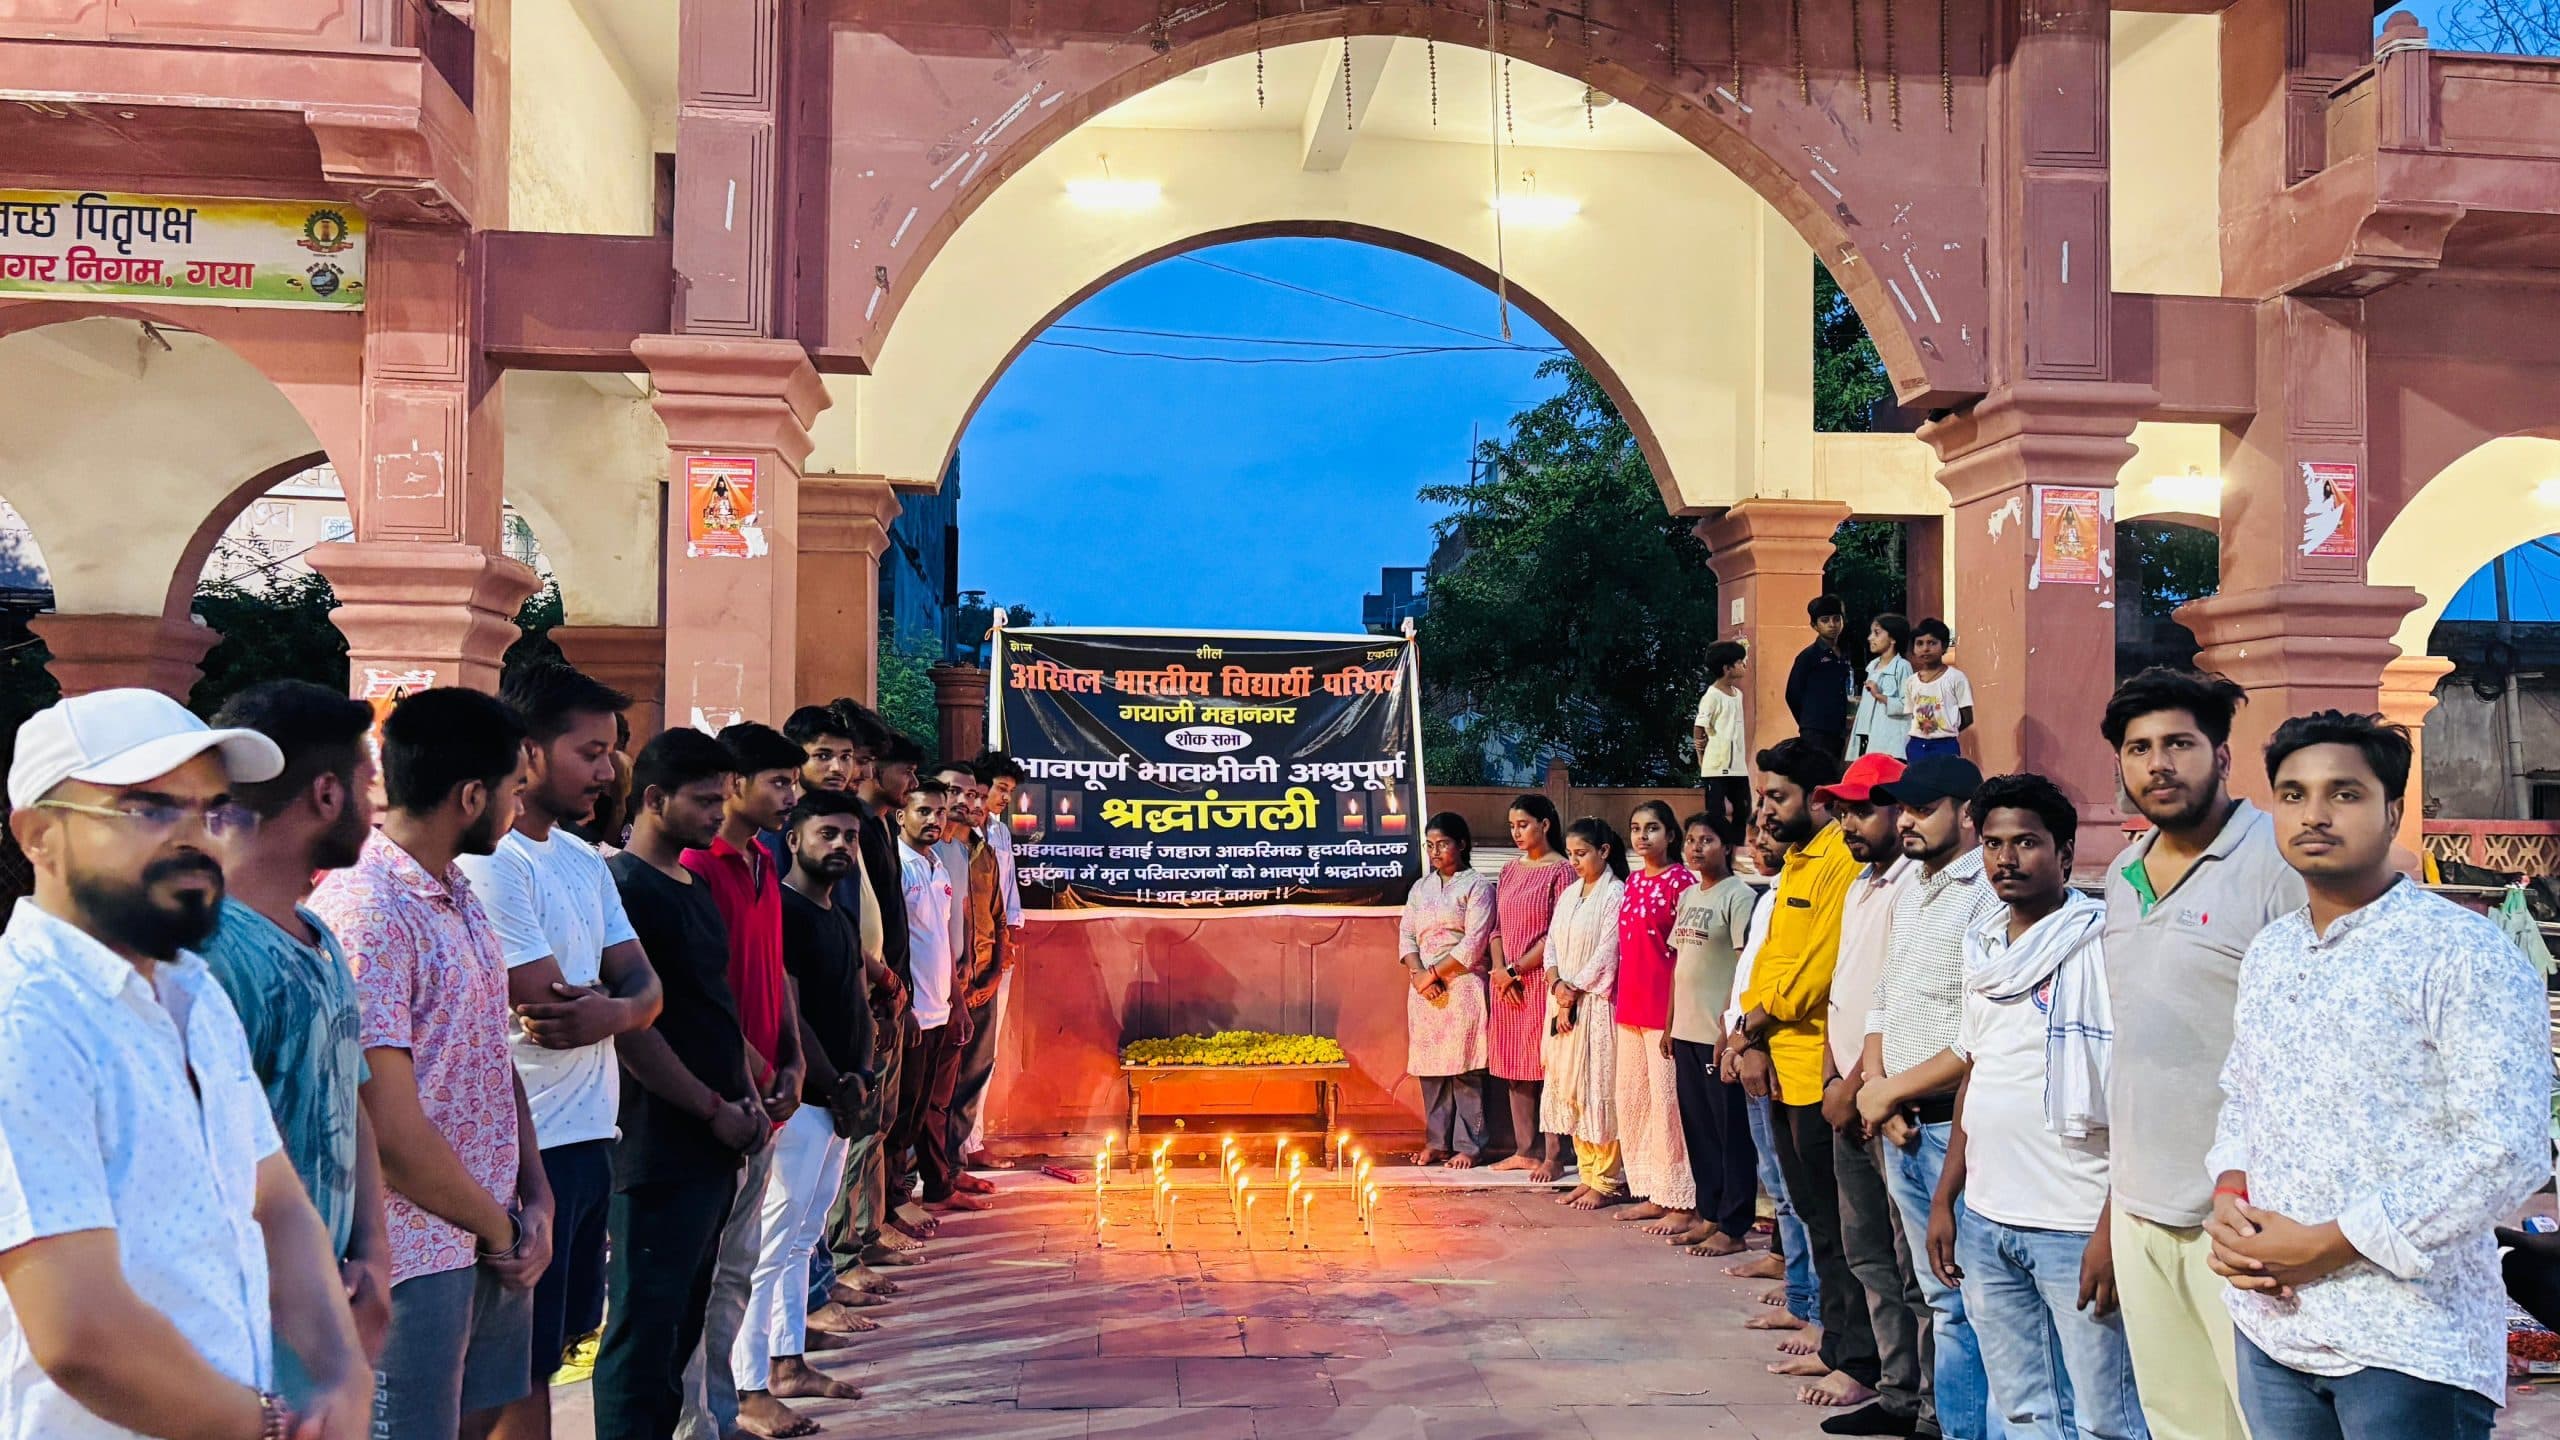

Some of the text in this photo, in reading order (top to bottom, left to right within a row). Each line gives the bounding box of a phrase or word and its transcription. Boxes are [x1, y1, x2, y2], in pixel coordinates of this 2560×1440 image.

[72, 193, 198, 255] पितृपक्ष
[0, 245, 255, 288] गर निगम, गया
[1009, 640, 1033, 653] ज्ञान
[1196, 644, 1223, 659] शील
[1366, 648, 1399, 660] एकता
[1009, 660, 1104, 695] अखिल
[1115, 664, 1213, 696] भारतीय
[1220, 664, 1314, 697] विद्यार्थी
[1119, 700, 1297, 725] गयाजी महानगर
[1175, 733, 1241, 746] शोक सभा
[1138, 755, 1280, 783] भावभीनी
[1288, 751, 1406, 792] अश्रुपूर्ण
[1100, 787, 1320, 832] श्रद्धांजली
[1012, 840, 1408, 860] अहमदाबाद हवाई जहाज आकस्मिक हृदयविदारक
[1017, 860, 1403, 886] दुर्घटना में मृत परिवारजनों को भावपूर्ण श्रद्धांजली
[1225, 888, 1269, 902] नमन
